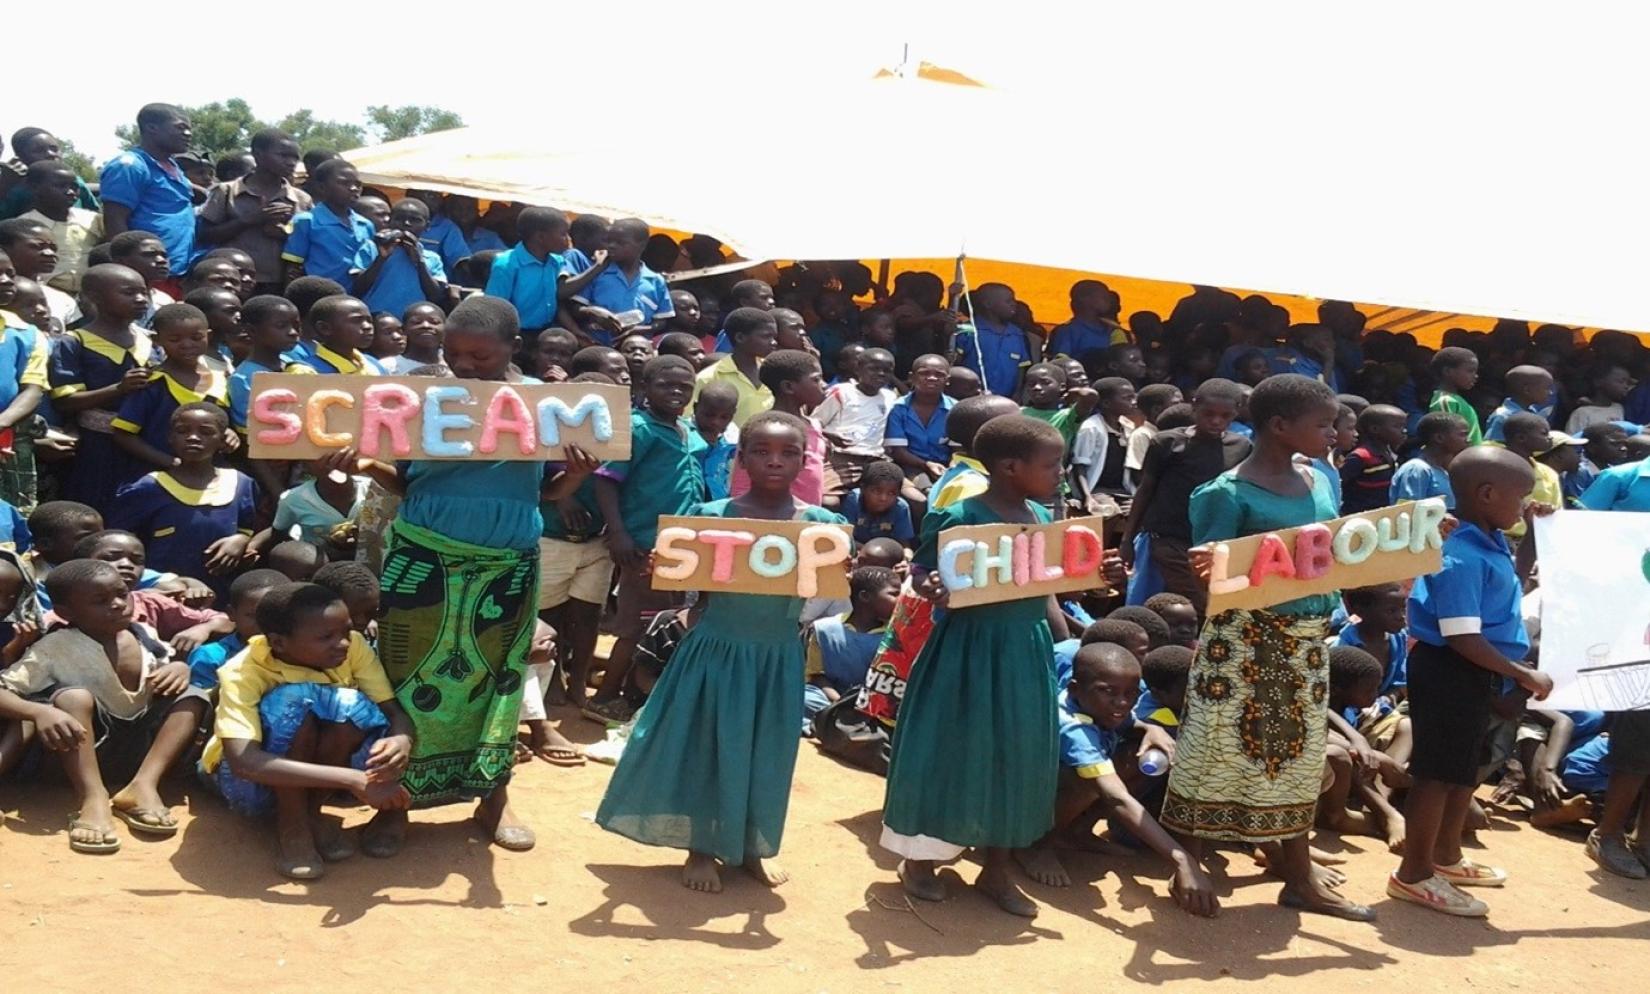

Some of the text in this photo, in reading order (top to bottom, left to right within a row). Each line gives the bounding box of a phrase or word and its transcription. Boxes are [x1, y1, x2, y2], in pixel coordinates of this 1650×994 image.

[254, 383, 613, 457] SCREAM
[653, 524, 851, 597] STOP
[938, 524, 1101, 592] CHILD
[1209, 497, 1447, 594] LABOUR
